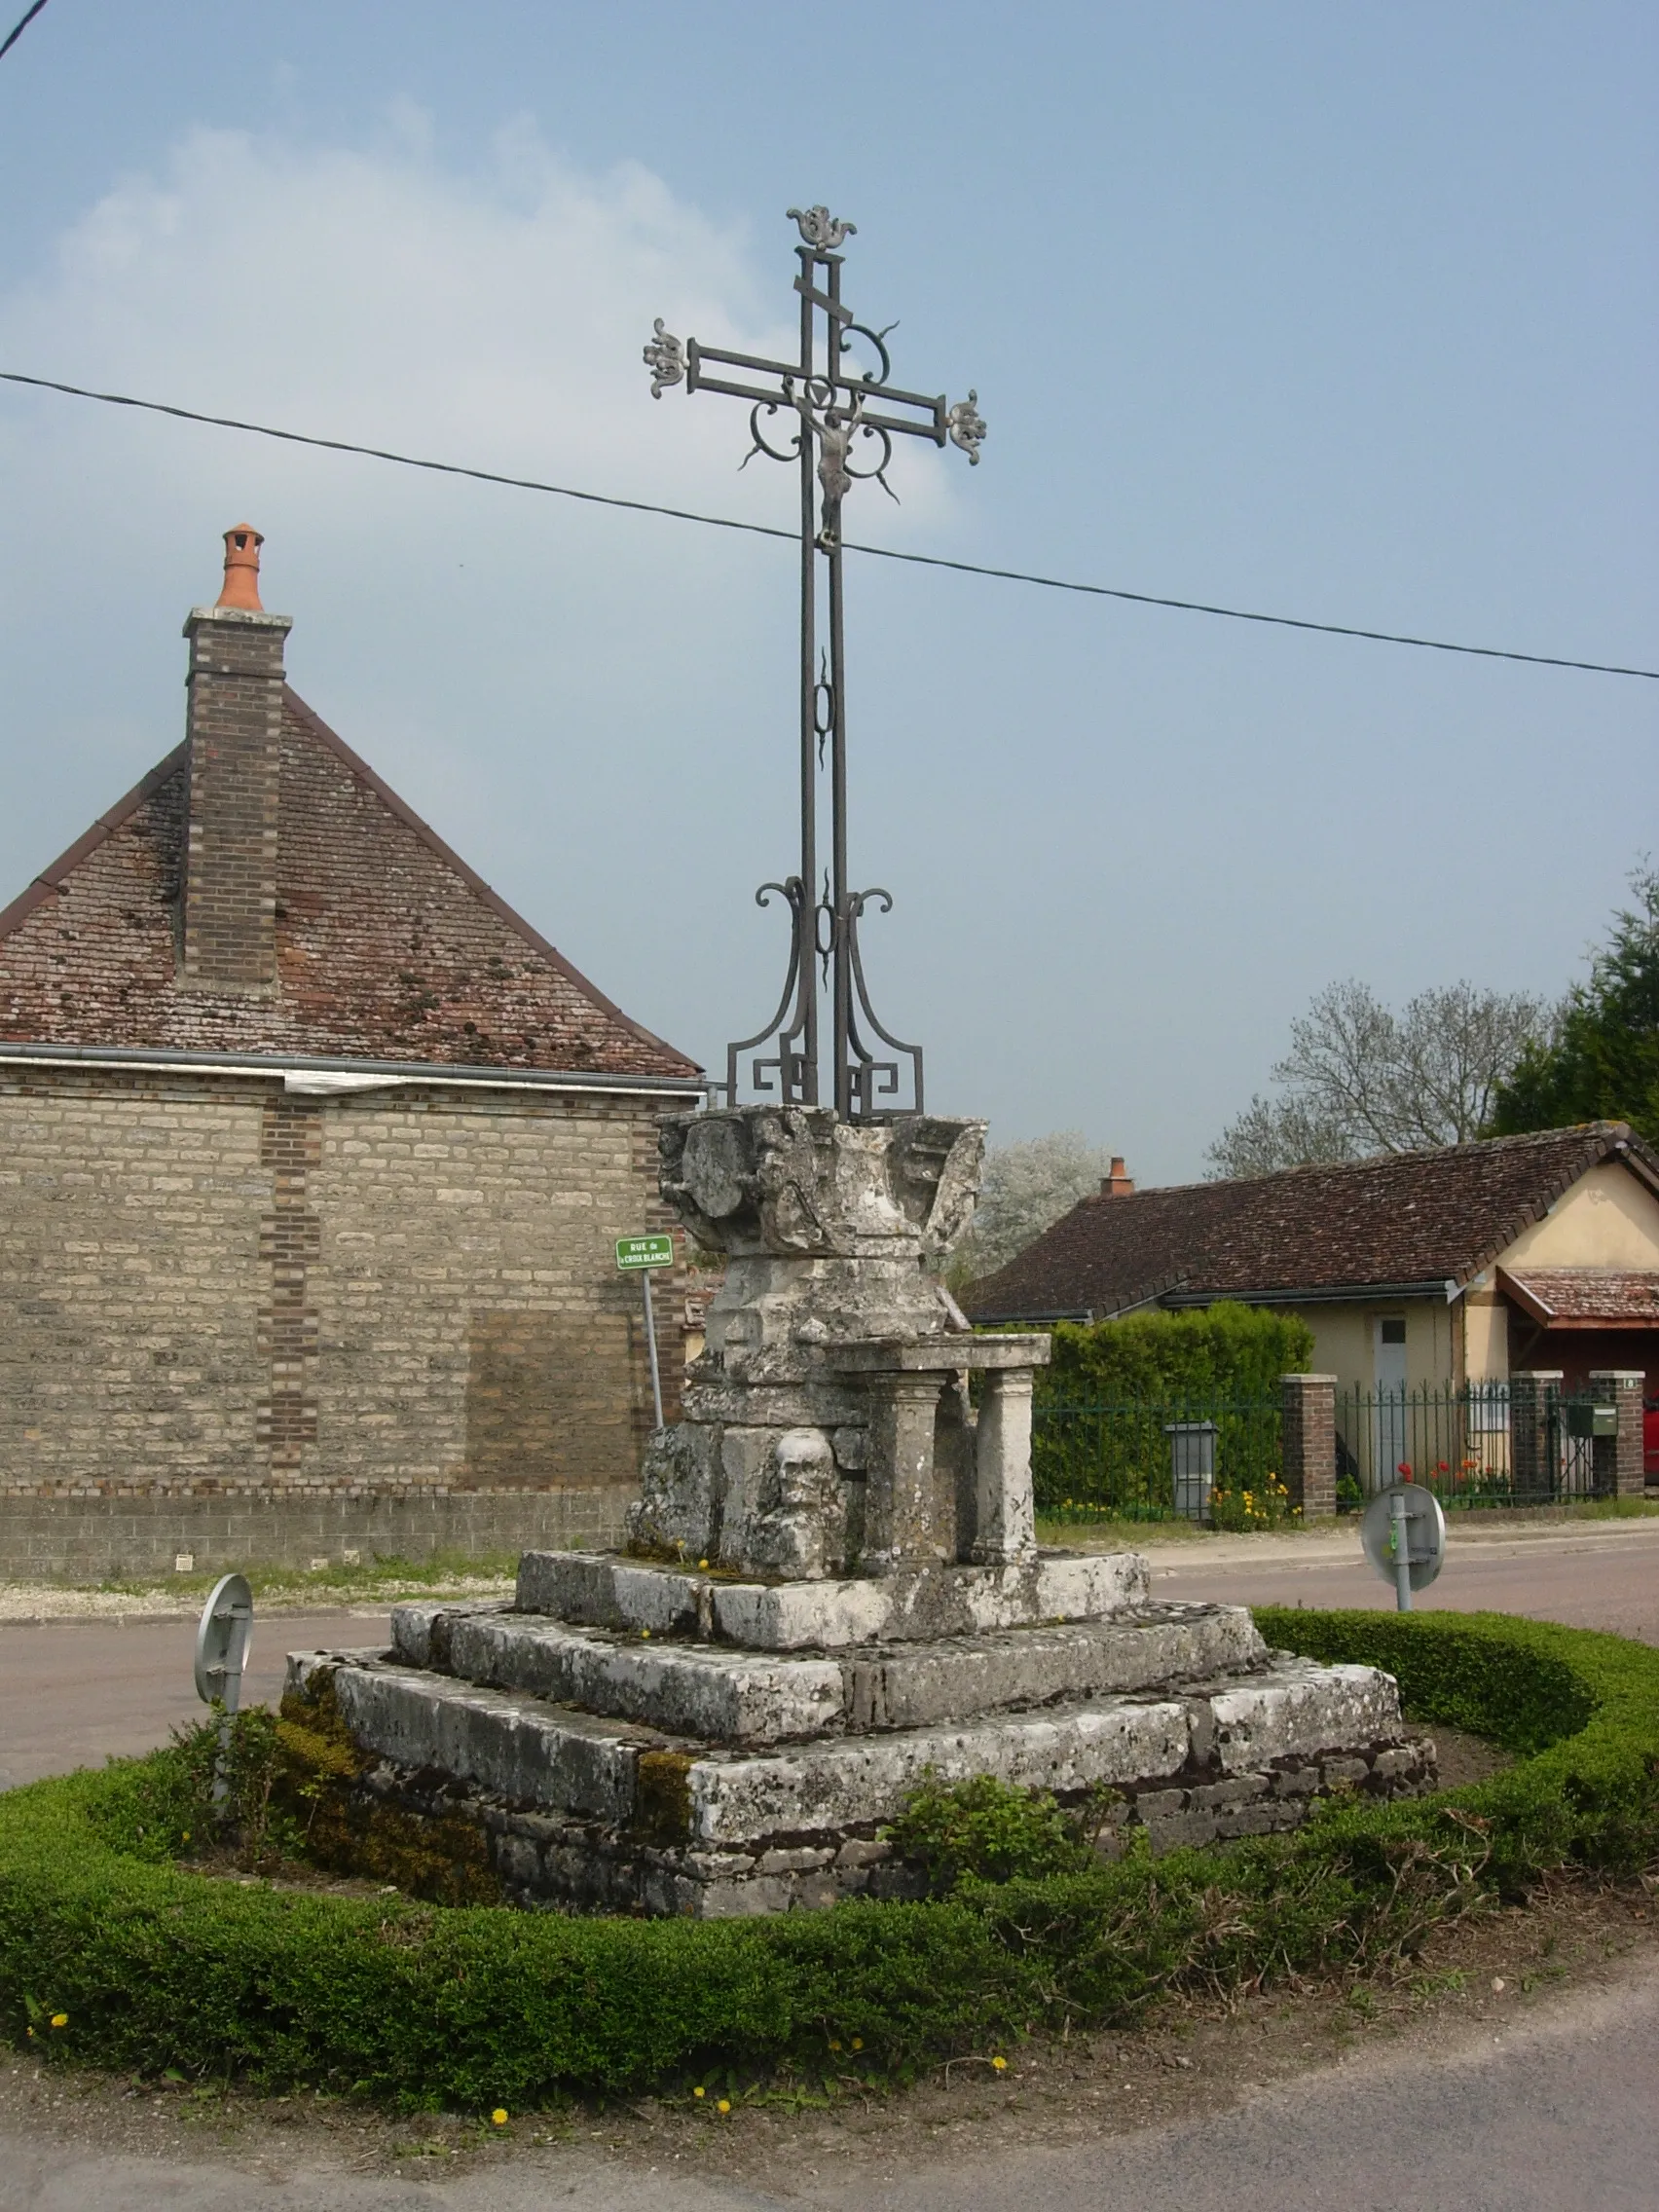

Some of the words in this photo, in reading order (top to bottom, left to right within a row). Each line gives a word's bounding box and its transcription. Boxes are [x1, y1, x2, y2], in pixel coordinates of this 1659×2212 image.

[630, 1242, 646, 1251] RUE
[624, 1254, 643, 1264] CROIX
[644, 1252, 669, 1262] BLANCHE
